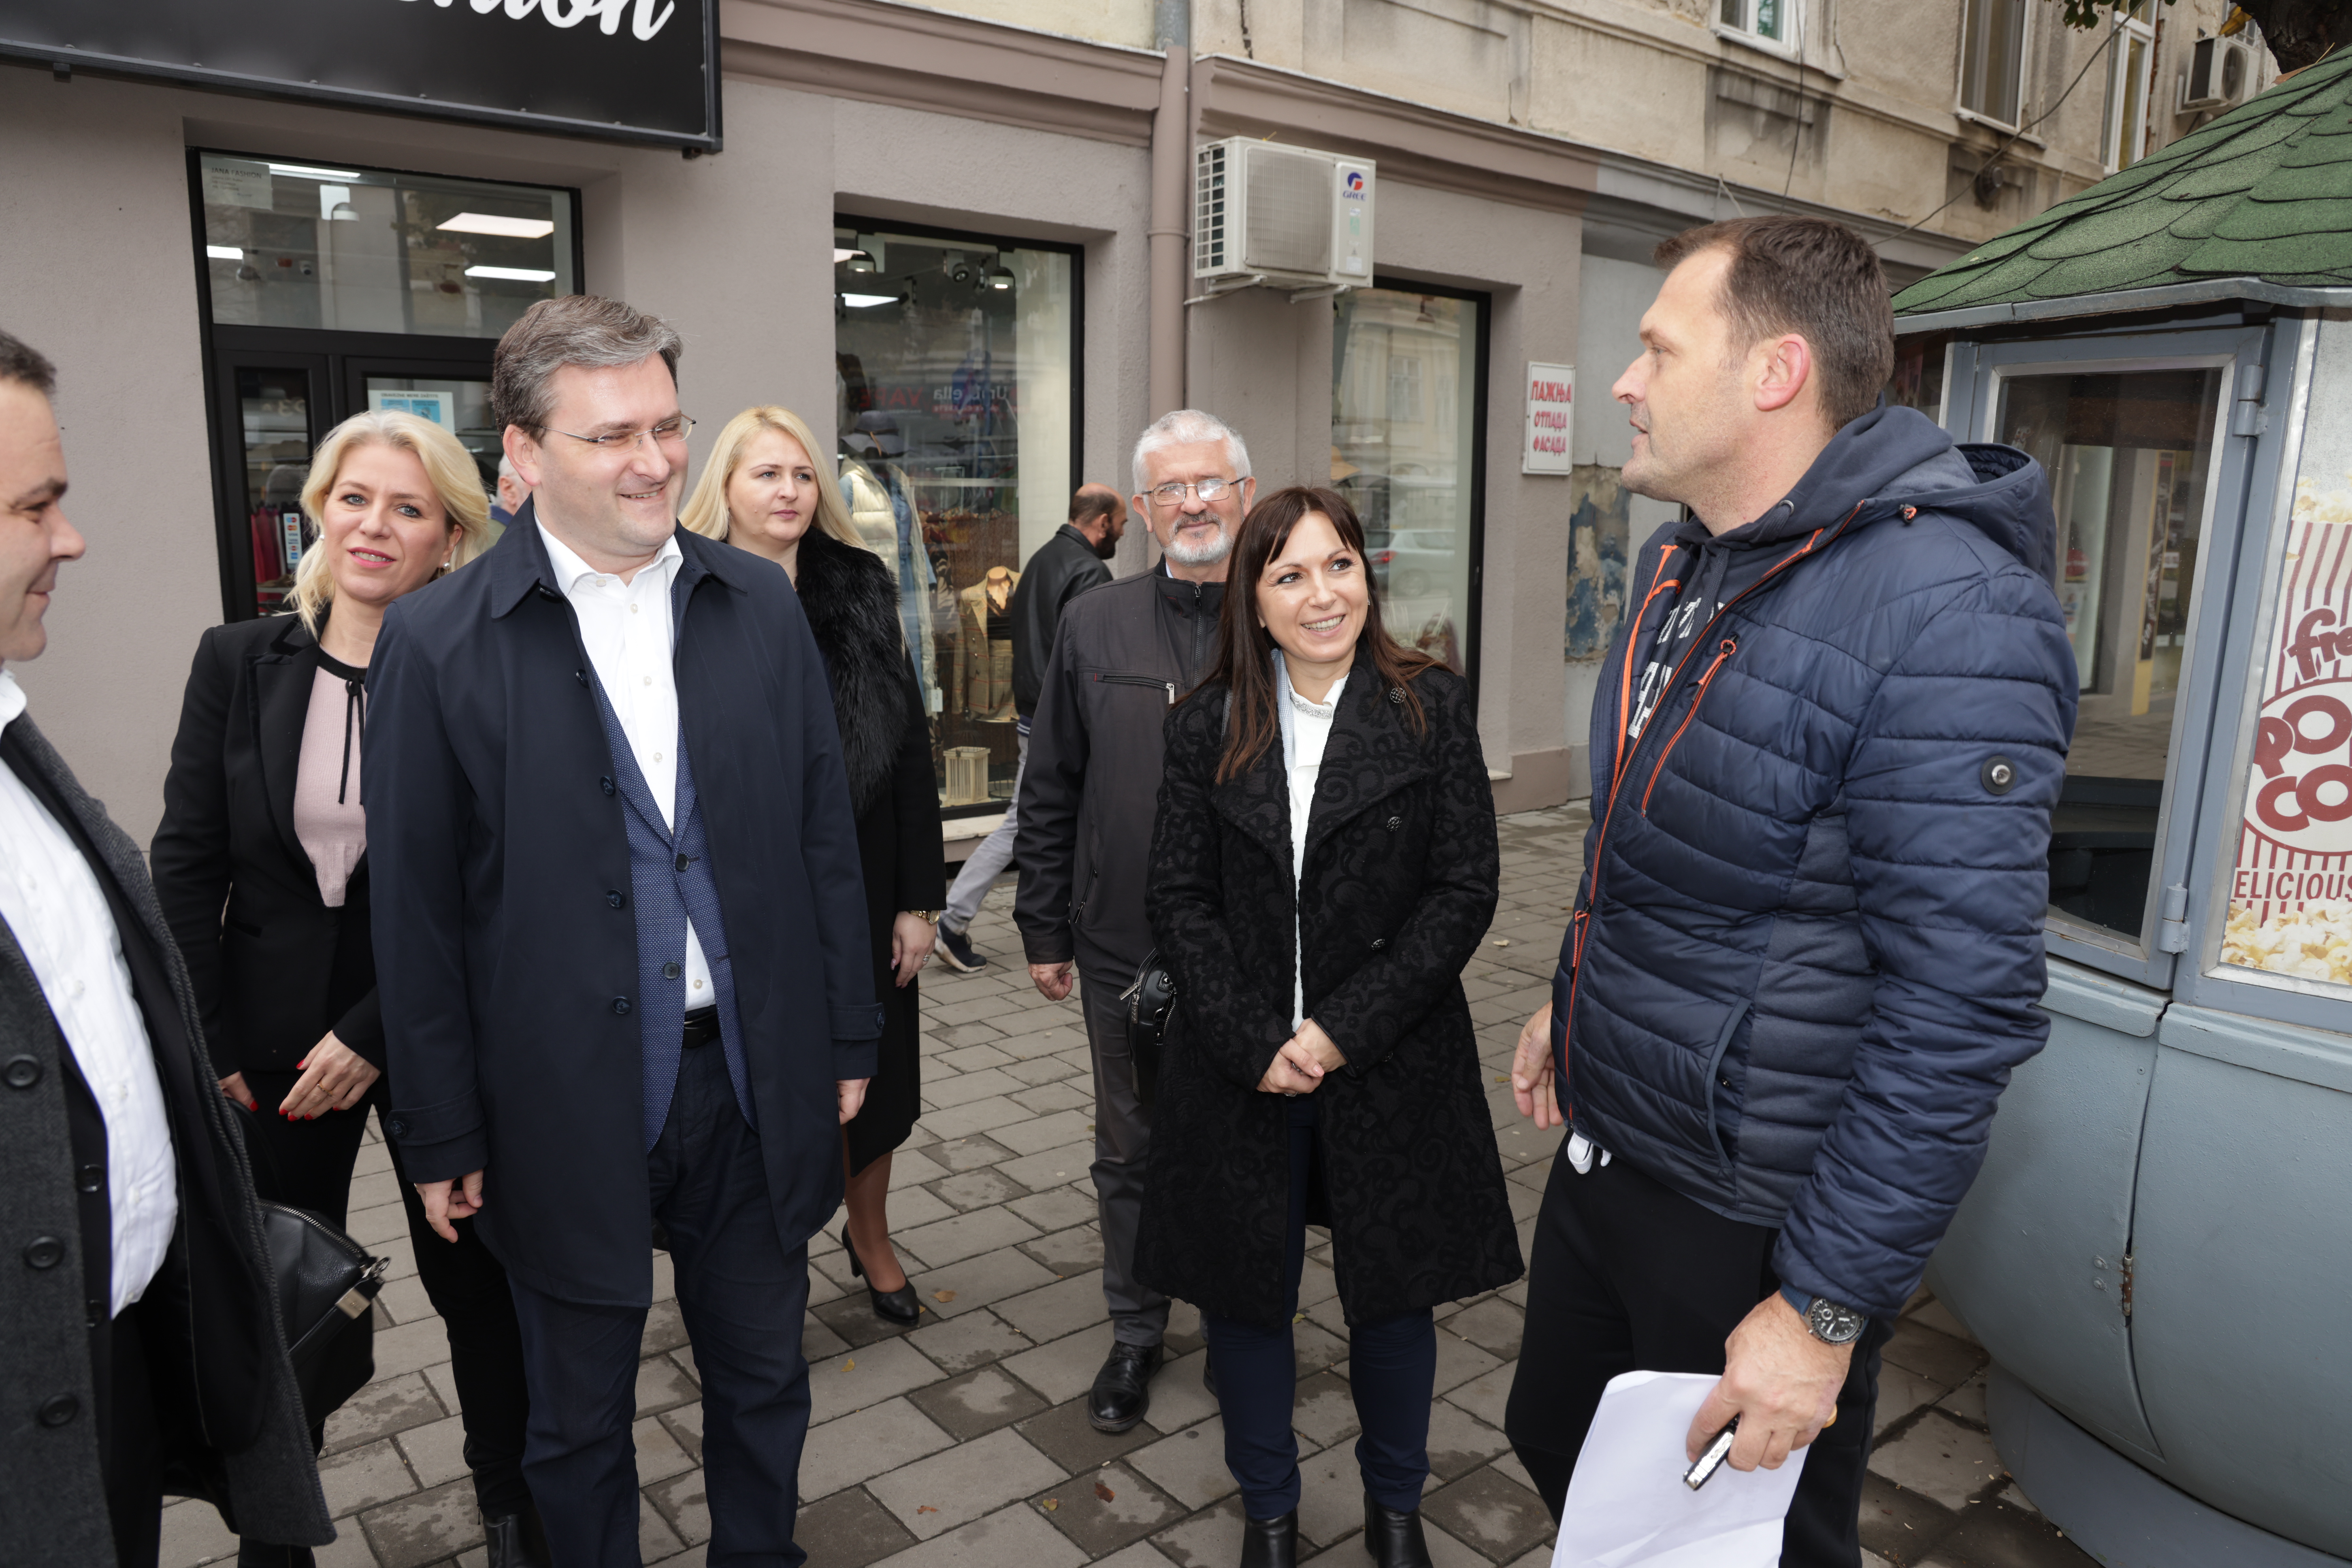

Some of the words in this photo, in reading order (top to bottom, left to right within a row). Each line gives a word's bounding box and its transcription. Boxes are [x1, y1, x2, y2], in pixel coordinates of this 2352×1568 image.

[231, 169, 262, 179] FASHION
[1343, 190, 1367, 202] GREE
[1531, 380, 1572, 403] ПАЖЊА
[1534, 411, 1567, 432] ОТПАДА
[1534, 435, 1566, 456] ФАСАДА
[2253, 695, 2352, 779] PO
